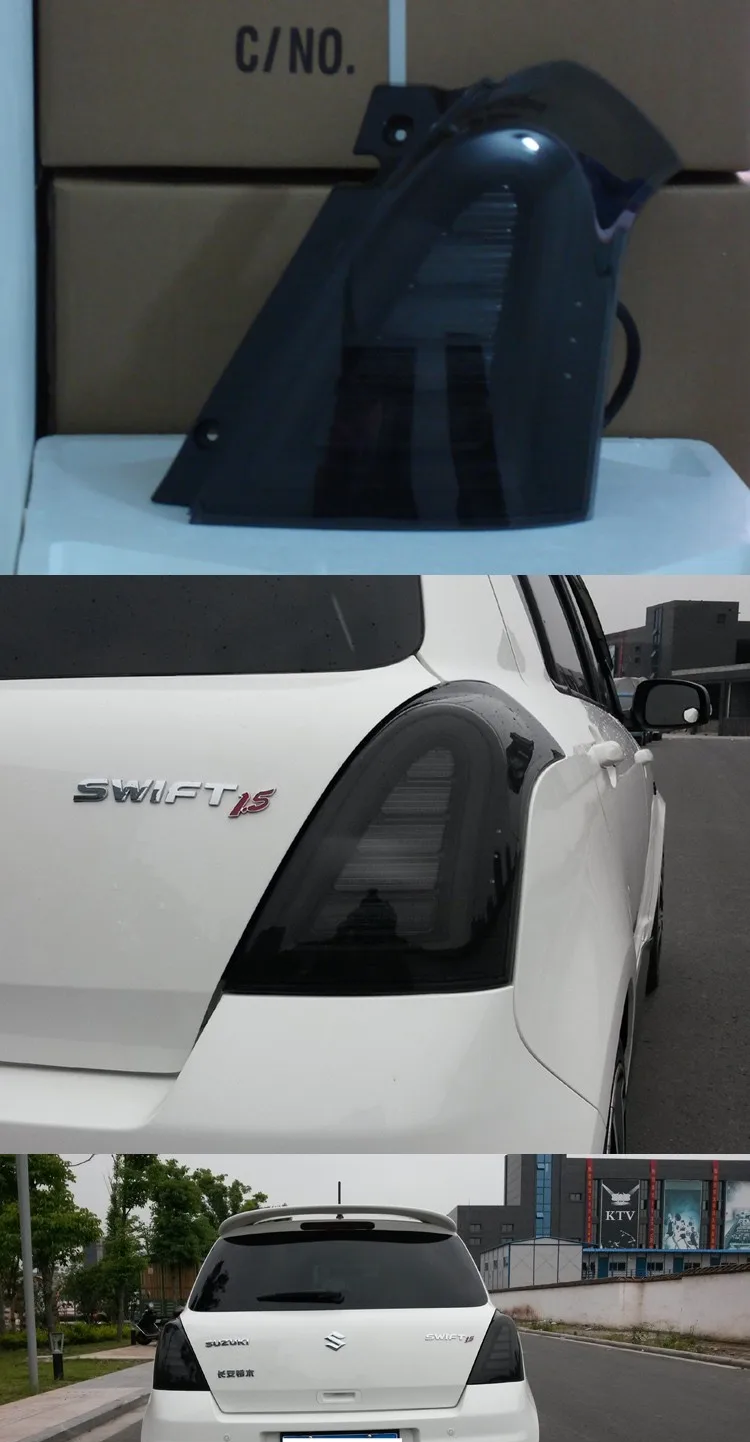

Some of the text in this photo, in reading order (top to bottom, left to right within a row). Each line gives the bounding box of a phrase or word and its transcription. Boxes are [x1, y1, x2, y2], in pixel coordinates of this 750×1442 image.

[236, 25, 355, 75] C/NO.
[73, 778, 277, 818] SWIFT 1.5
[605, 1210, 636, 1221] KTV
[424, 1333, 466, 1341] SWIFT
[205, 1339, 249, 1348] SUZUKI
